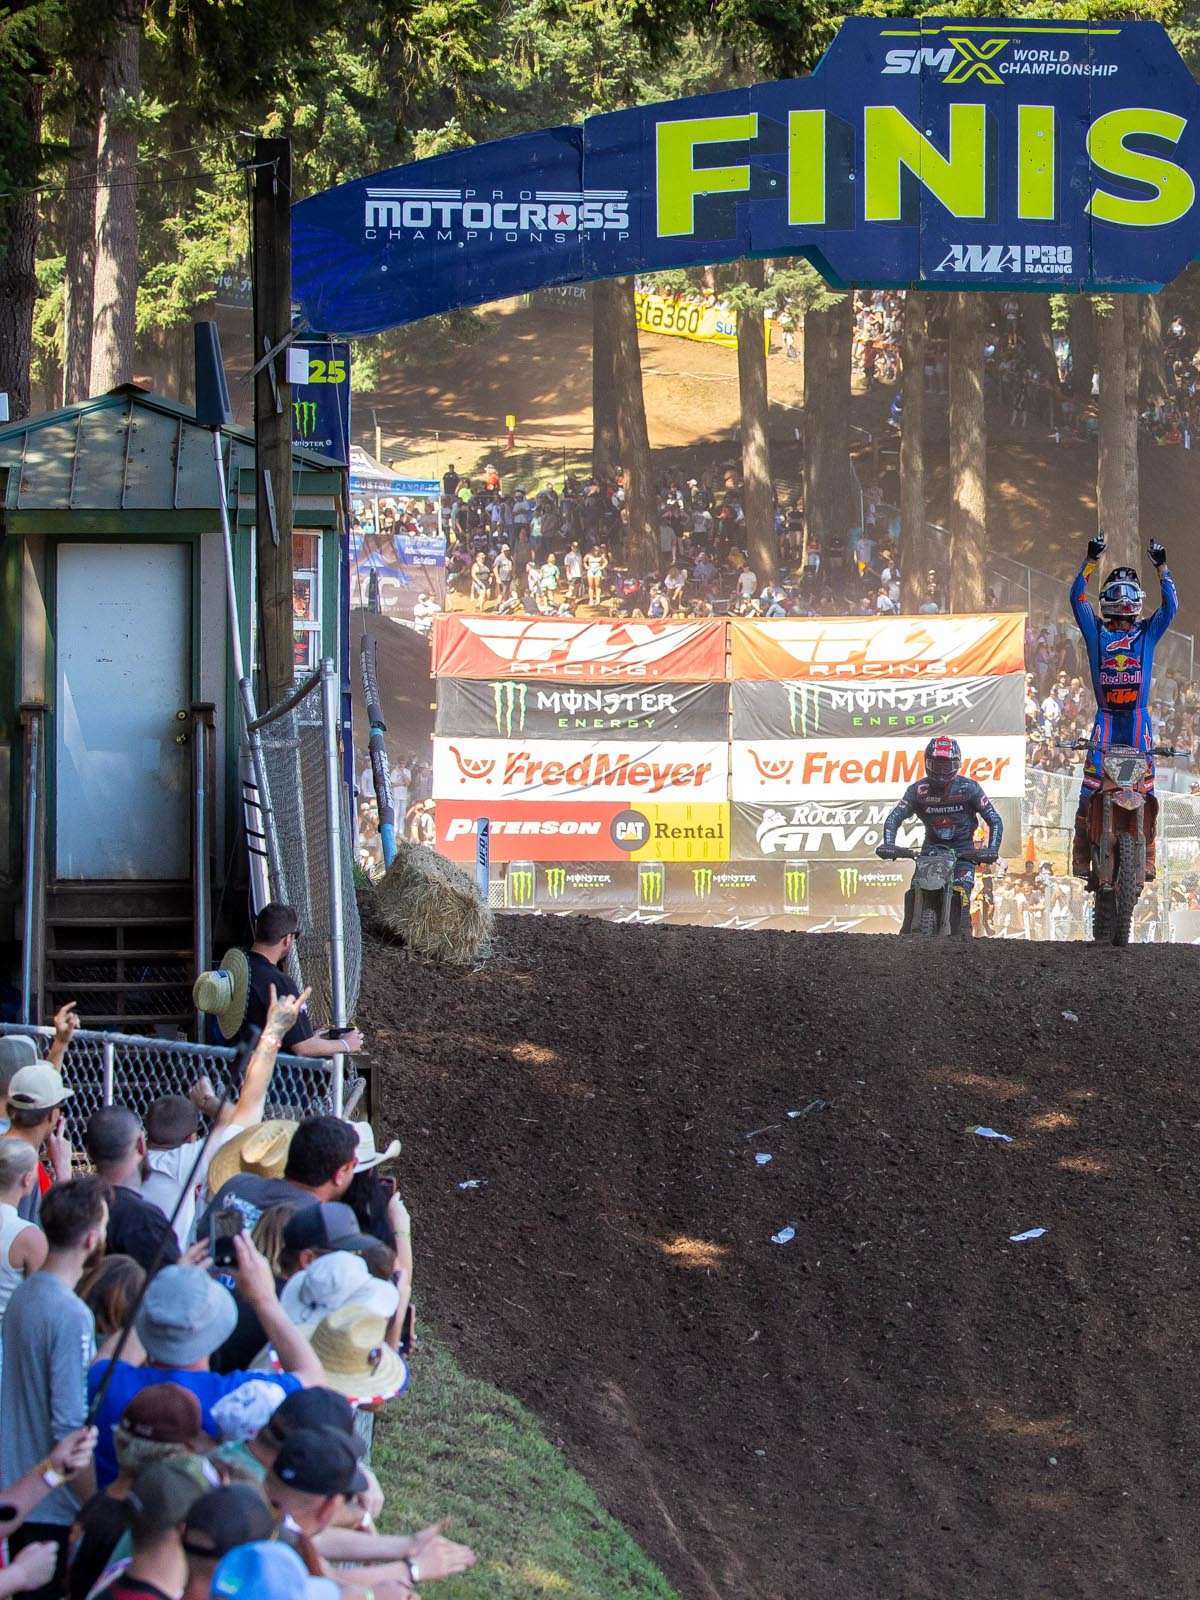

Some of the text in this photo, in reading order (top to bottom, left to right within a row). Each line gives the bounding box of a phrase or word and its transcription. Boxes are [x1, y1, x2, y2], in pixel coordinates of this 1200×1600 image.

[880, 38, 1010, 84] SMX
[1014, 50, 1070, 62] WORLD
[999, 63, 1119, 76] CHAMPIONSHIP
[465, 189, 533, 201] PRO
[364, 200, 630, 231] MOTOCROSS
[364, 229, 631, 243] CHAMPIONSHIP
[931, 244, 1073, 273] AMA PRO
[1025, 264, 1073, 274] RACING
[635, 301, 700, 333] sta360
[308, 359, 347, 384] 25
[459, 618, 709, 663] FLY
[510, 663, 651, 676] RACING
[809, 663, 948, 676] RACING
[1101, 670, 1141, 685] Red Bull
[536, 688, 678, 715] MONSTER
[831, 686, 974, 713] MONSTER
[1107, 688, 1138, 704] KTM
[558, 718, 656, 729] ENERGY
[852, 714, 951, 726] ENERGY
[1116, 759, 1137, 782] 1
[790, 808, 866, 825] ROCKY
[445, 818, 601, 842] PTERSON
[616, 821, 723, 841] CAT Rental
[566, 874, 611, 883] MONSTER
[713, 874, 757, 882] MONSTER
[859, 873, 904, 882] MONSTER
